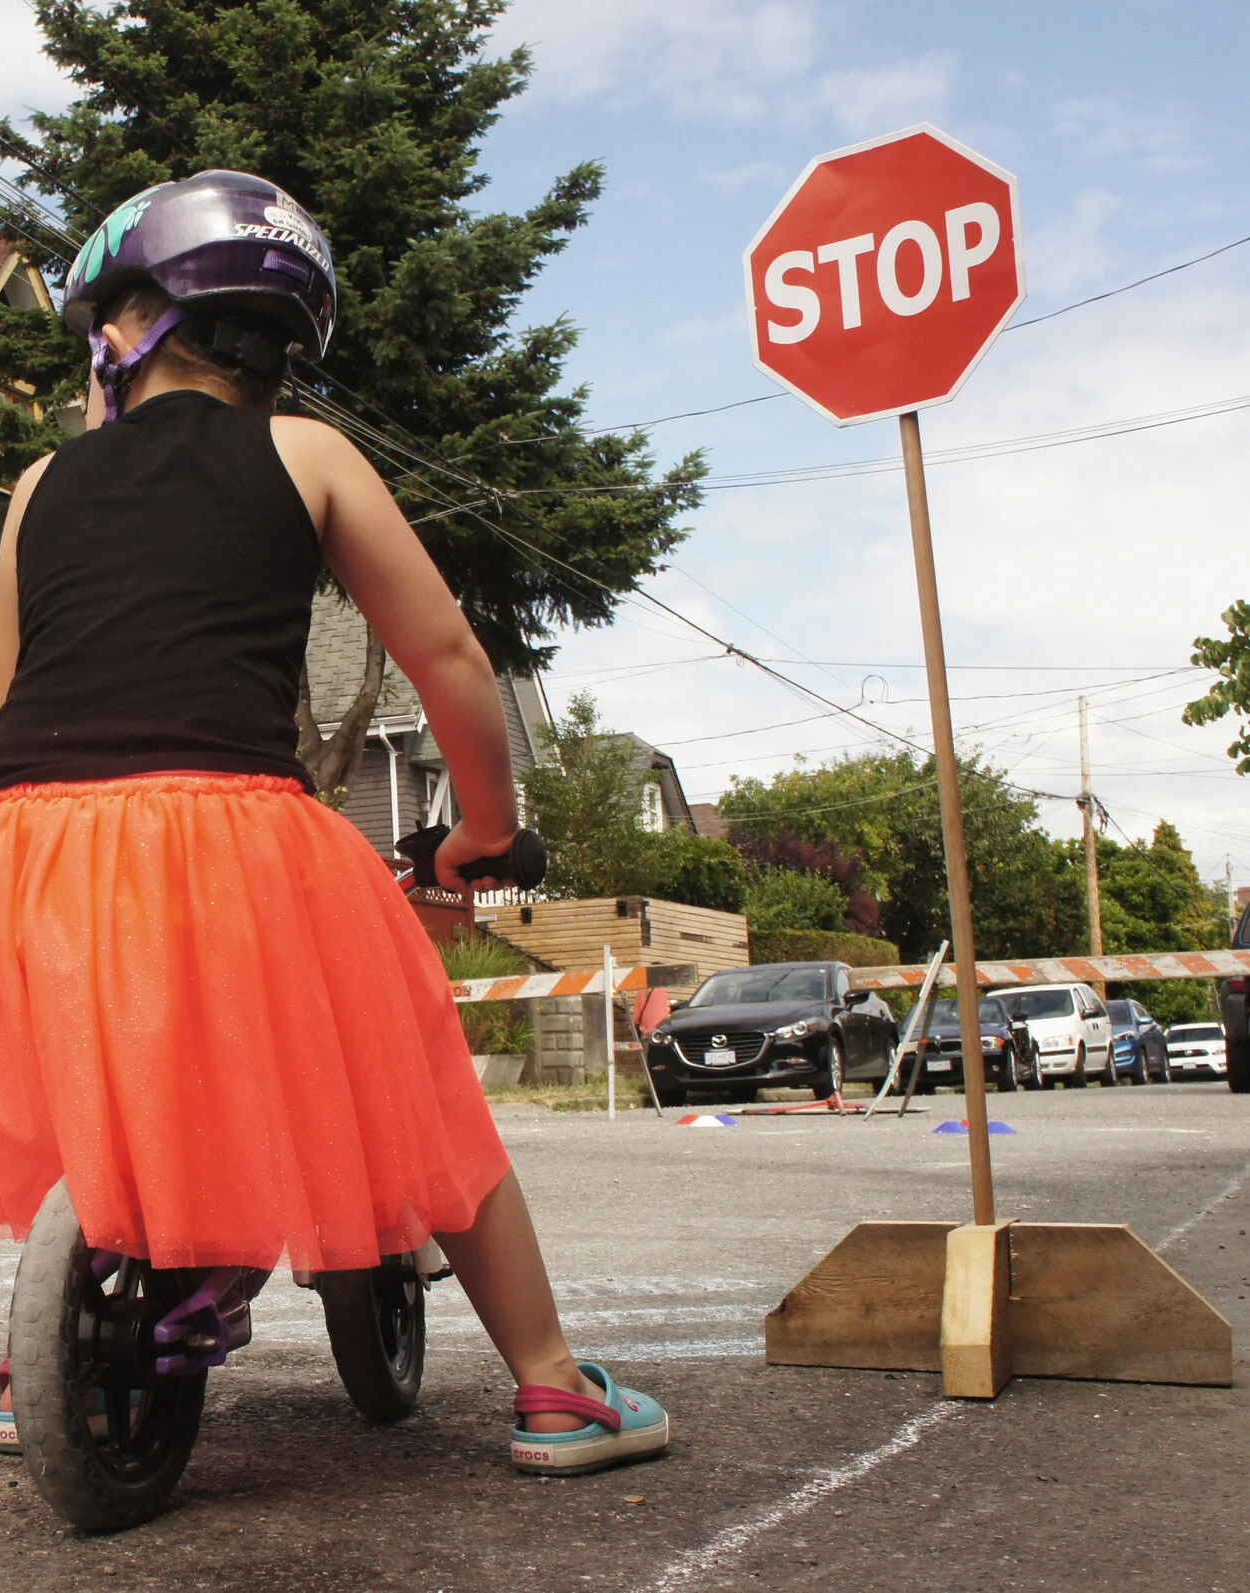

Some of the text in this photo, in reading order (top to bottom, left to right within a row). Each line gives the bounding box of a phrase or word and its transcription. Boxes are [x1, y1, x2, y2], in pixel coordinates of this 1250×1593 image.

[232, 222, 330, 272] SPECIALIZED
[764, 201, 1001, 345] STOP
[513, 1447, 550, 1461] crocs
